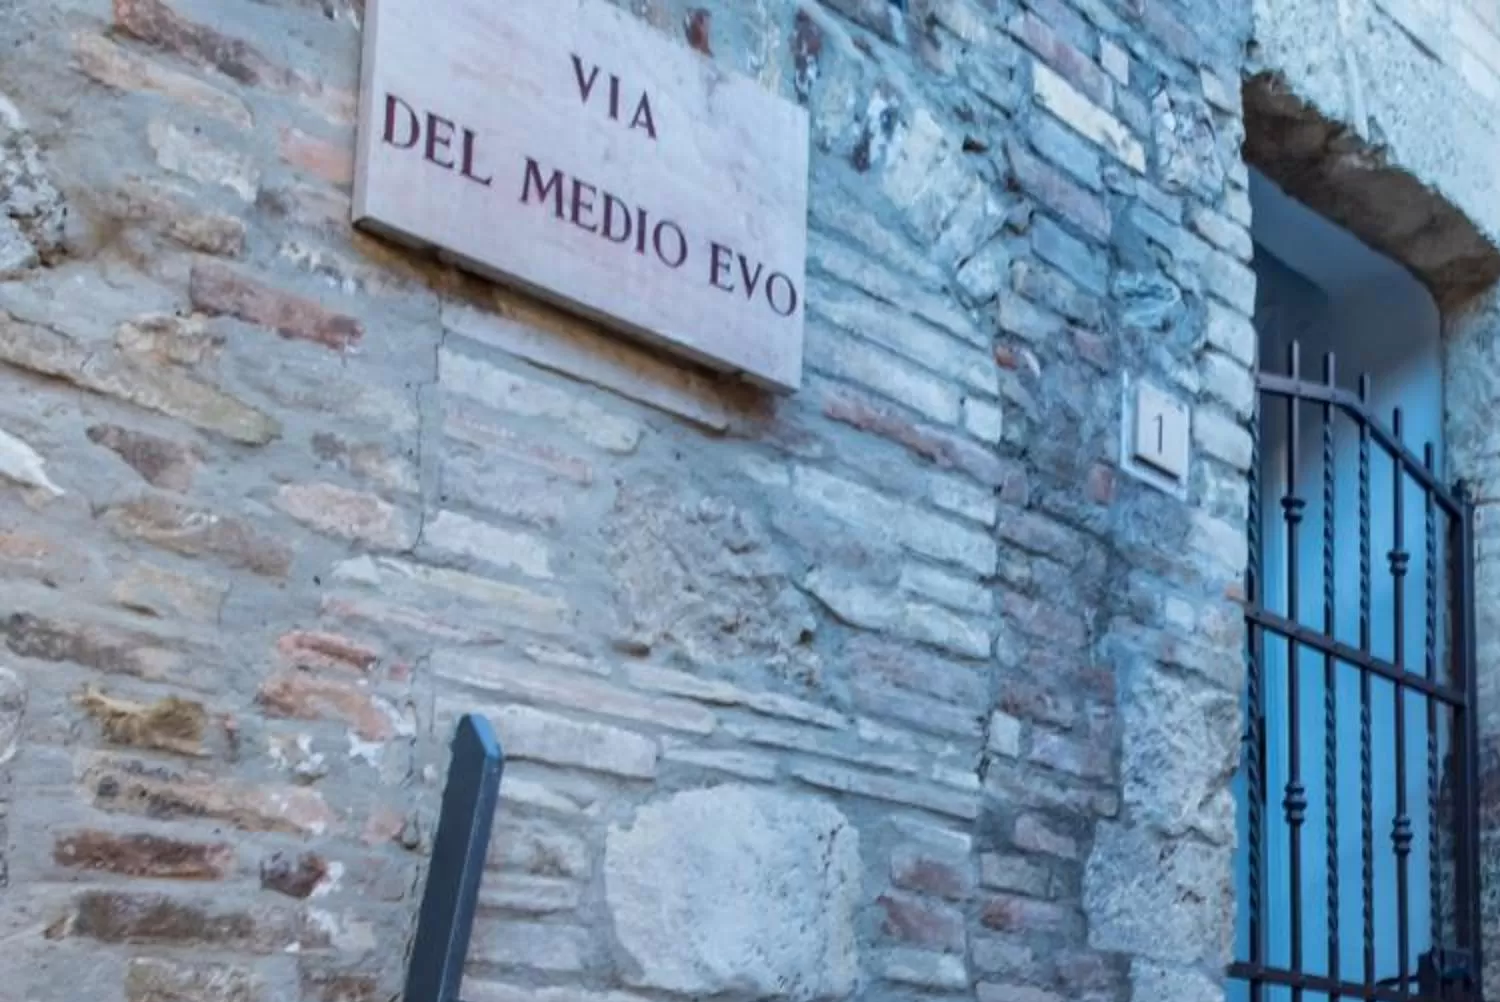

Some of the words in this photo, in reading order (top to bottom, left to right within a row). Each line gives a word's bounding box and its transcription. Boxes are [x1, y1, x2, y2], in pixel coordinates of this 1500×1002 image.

[570, 52, 657, 140] VIA
[382, 93, 492, 186] DEL
[519, 156, 688, 269] MEDIO
[709, 241, 797, 317] EVO
